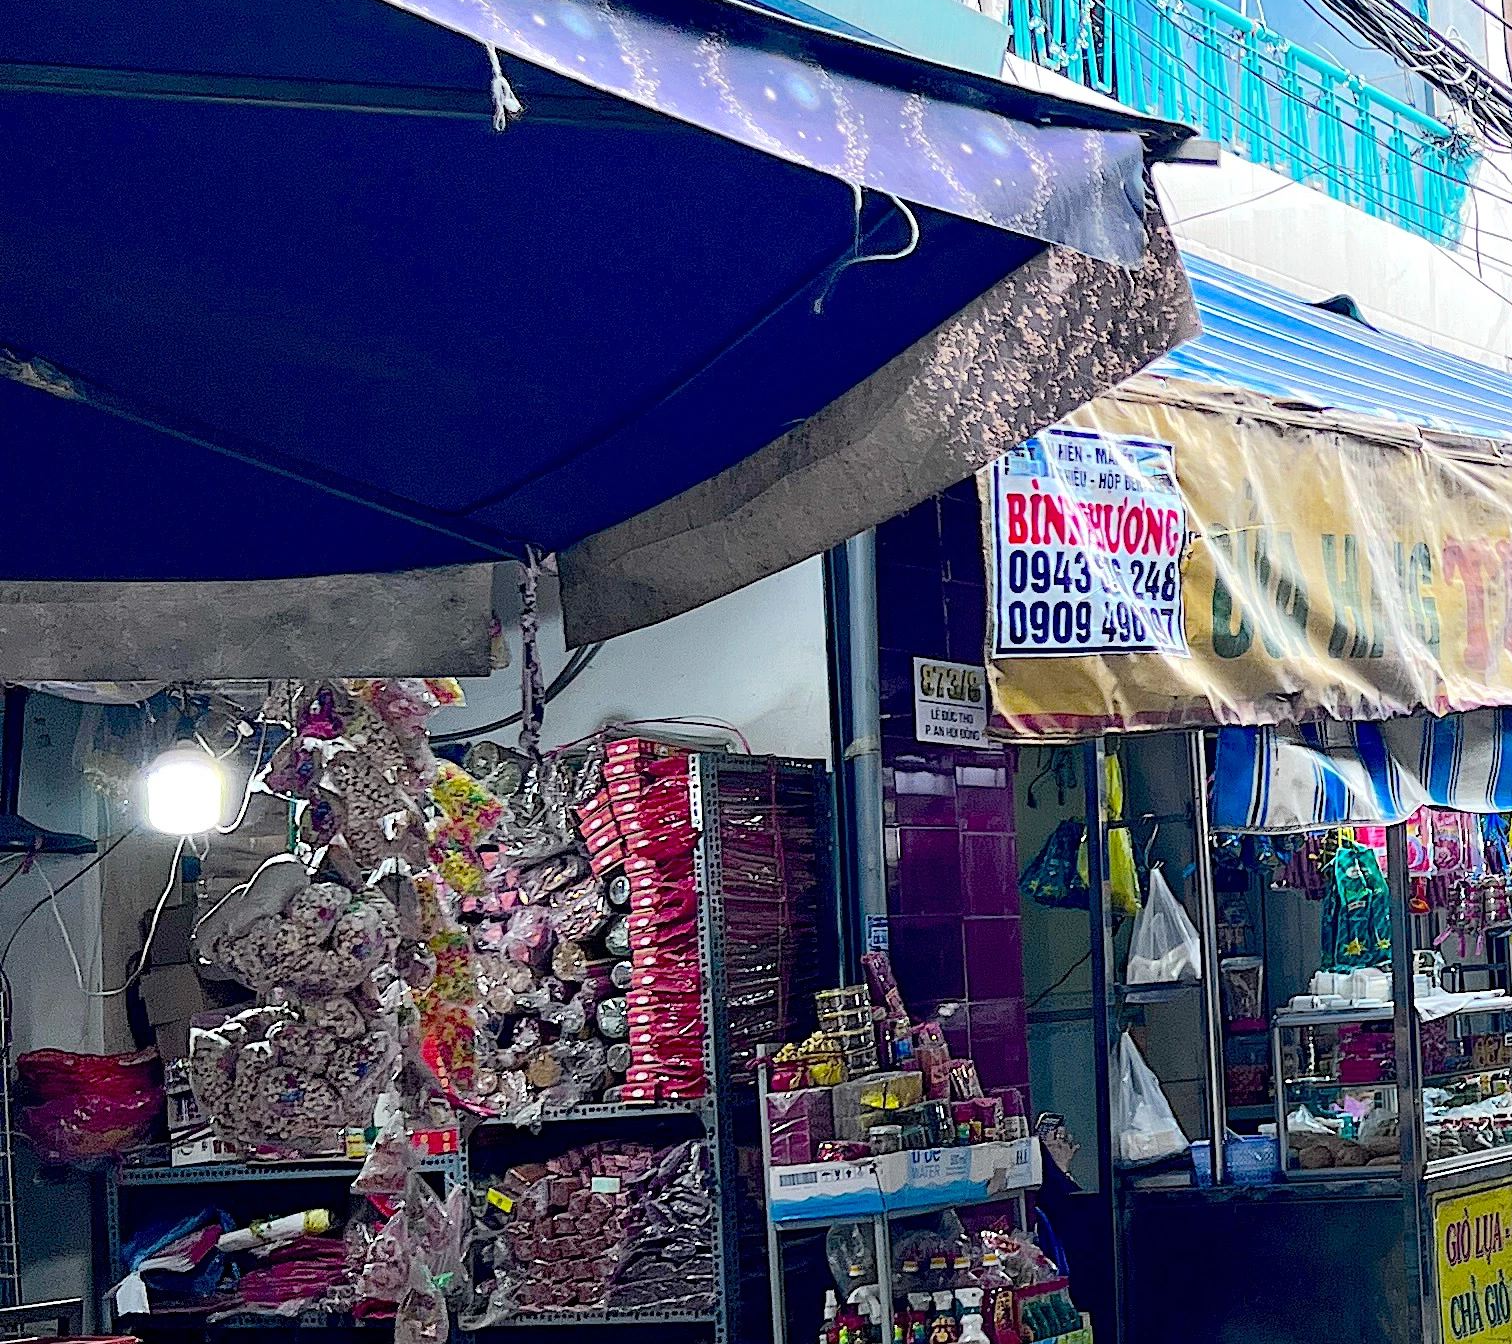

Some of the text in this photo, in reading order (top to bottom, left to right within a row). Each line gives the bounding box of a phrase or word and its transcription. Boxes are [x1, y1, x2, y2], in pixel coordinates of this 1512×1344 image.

[1009, 549, 1091, 594] 0943
[1130, 559, 1176, 602] 248
[1008, 600, 1092, 644] 0909
[1446, 1207, 1471, 1267] GIÒ
[1475, 1211, 1504, 1265] LỤA
